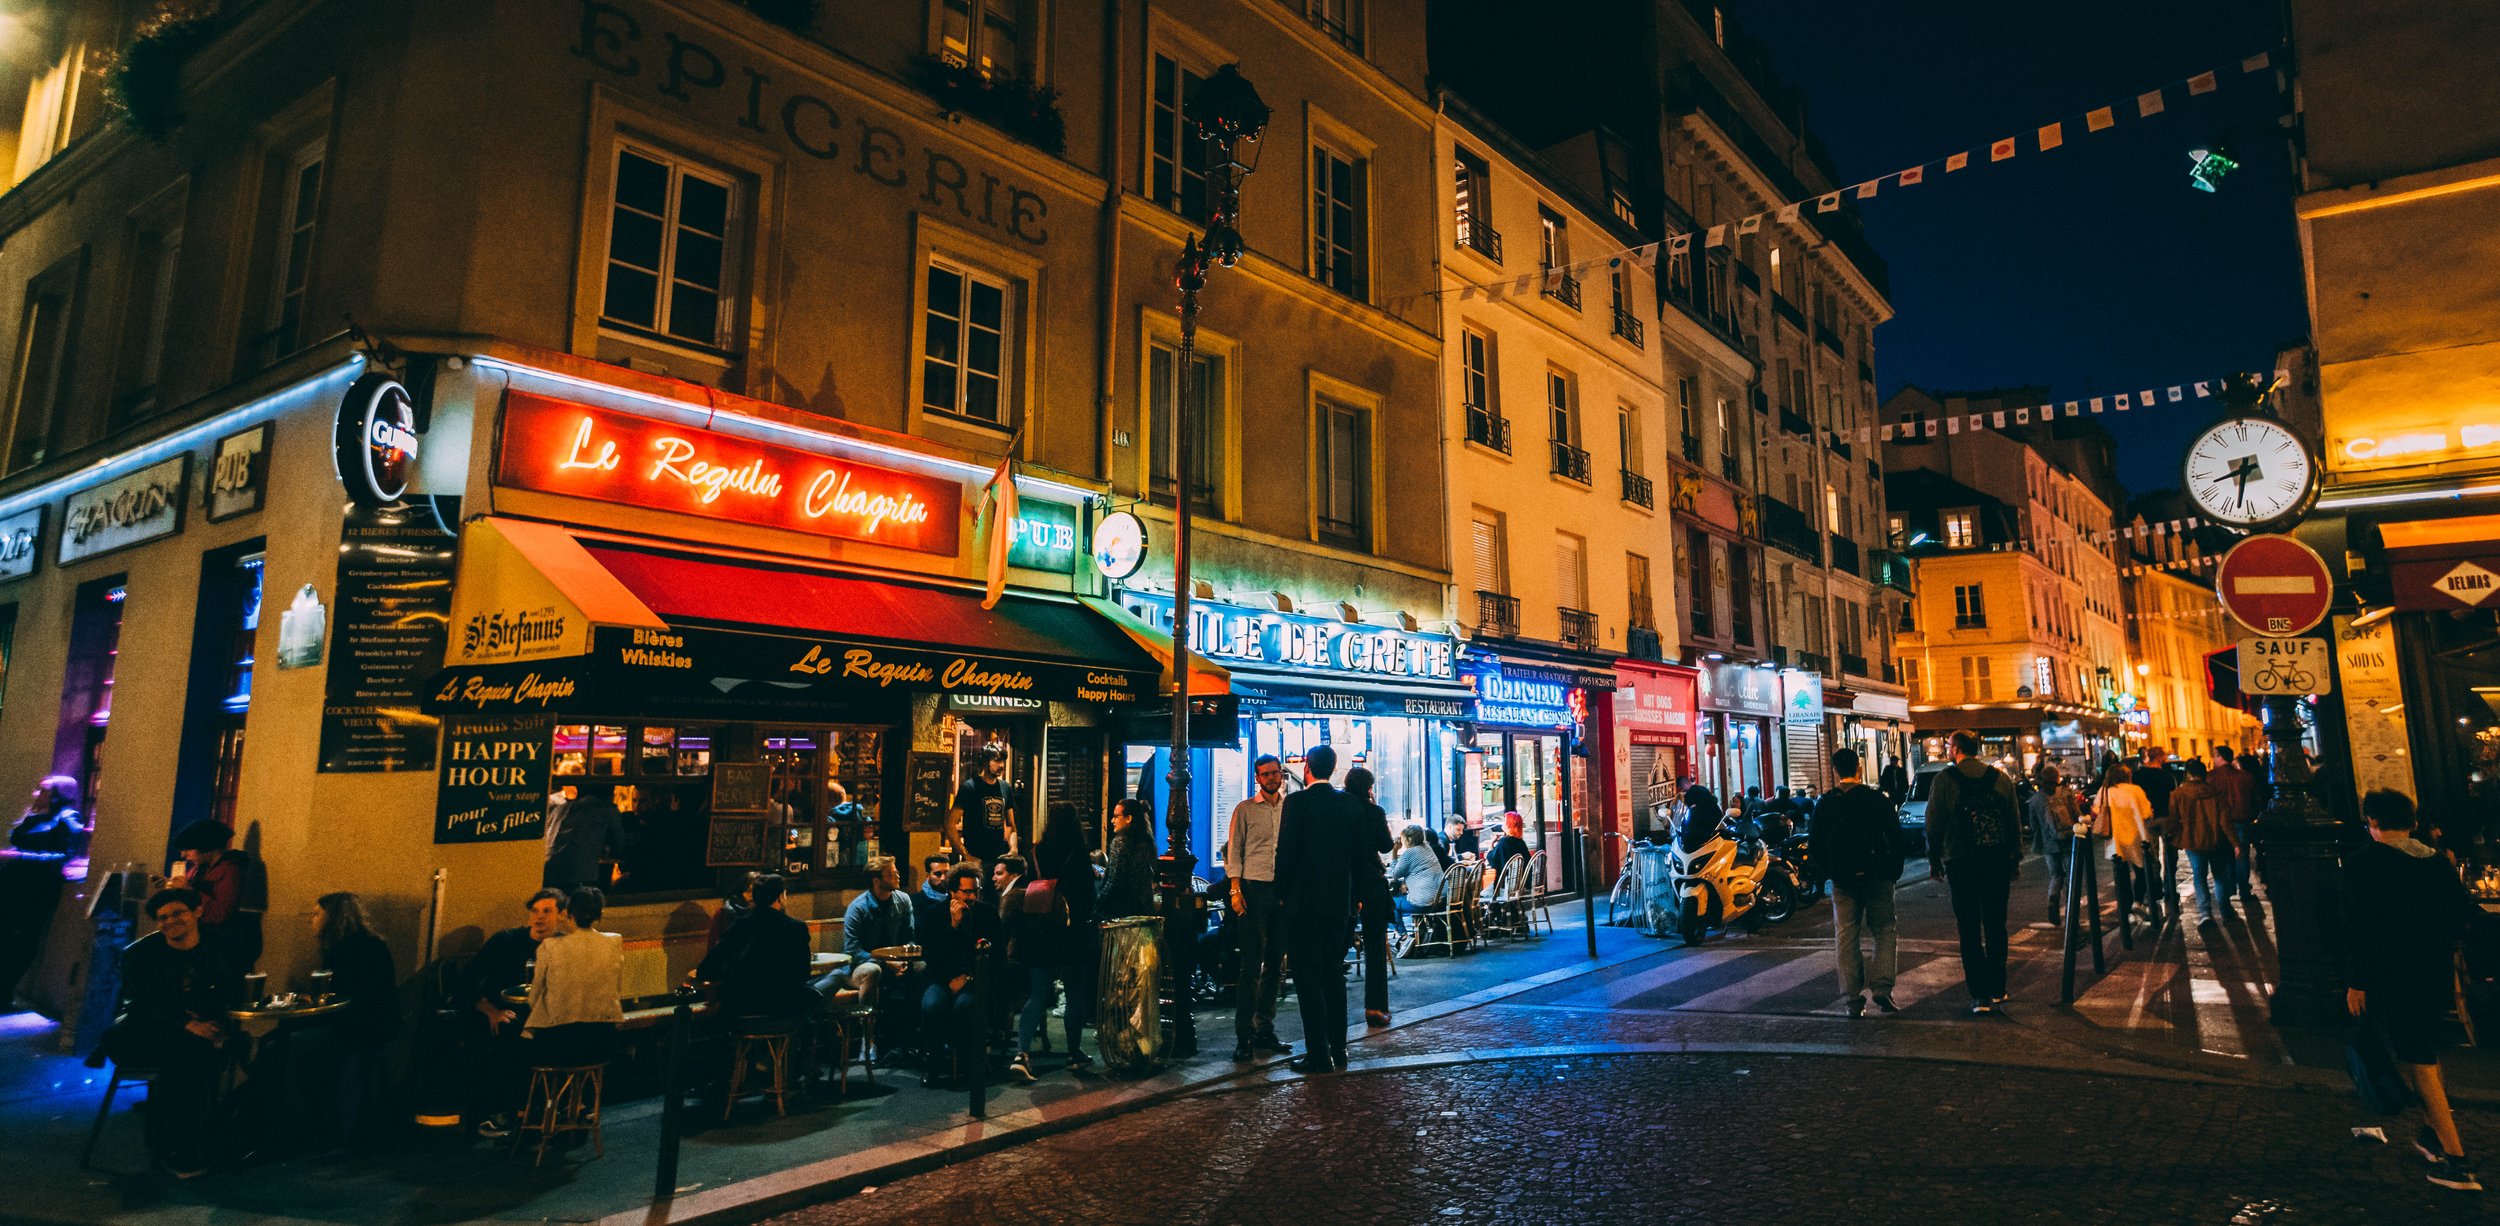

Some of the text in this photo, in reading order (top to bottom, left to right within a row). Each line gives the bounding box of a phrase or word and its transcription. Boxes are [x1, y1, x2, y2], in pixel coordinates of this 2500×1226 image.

[570, 0, 1049, 247] EPICERIE
[212, 452, 250, 494] PUB
[560, 416, 928, 534] Le Requin Chagrin
[1008, 517, 1074, 550] PUB
[2447, 574, 2491, 591] DELMAS
[633, 628, 684, 648] Bières
[2255, 641, 2311, 656] SAUF
[621, 647, 693, 669] Whiskies
[2346, 652, 2385, 669] SODAS
[789, 645, 1034, 694] Le Requin Chagrin
[1087, 671, 1128, 686] Cocktails
[435, 672, 576, 710] Le Requin Chagrin
[1077, 686, 1136, 702] Happy Hours
[1310, 692, 1366, 712] TRAITEUR
[1405, 698, 1464, 716] RESTAURANT
[452, 741, 543, 761] HAPPY
[447, 766, 527, 787] HOUR
[916, 767, 941, 780] LAGER
[1648, 783, 1675, 804] SAUSAGE
[447, 807, 489, 830] pour
[475, 811, 541, 836] les filles
